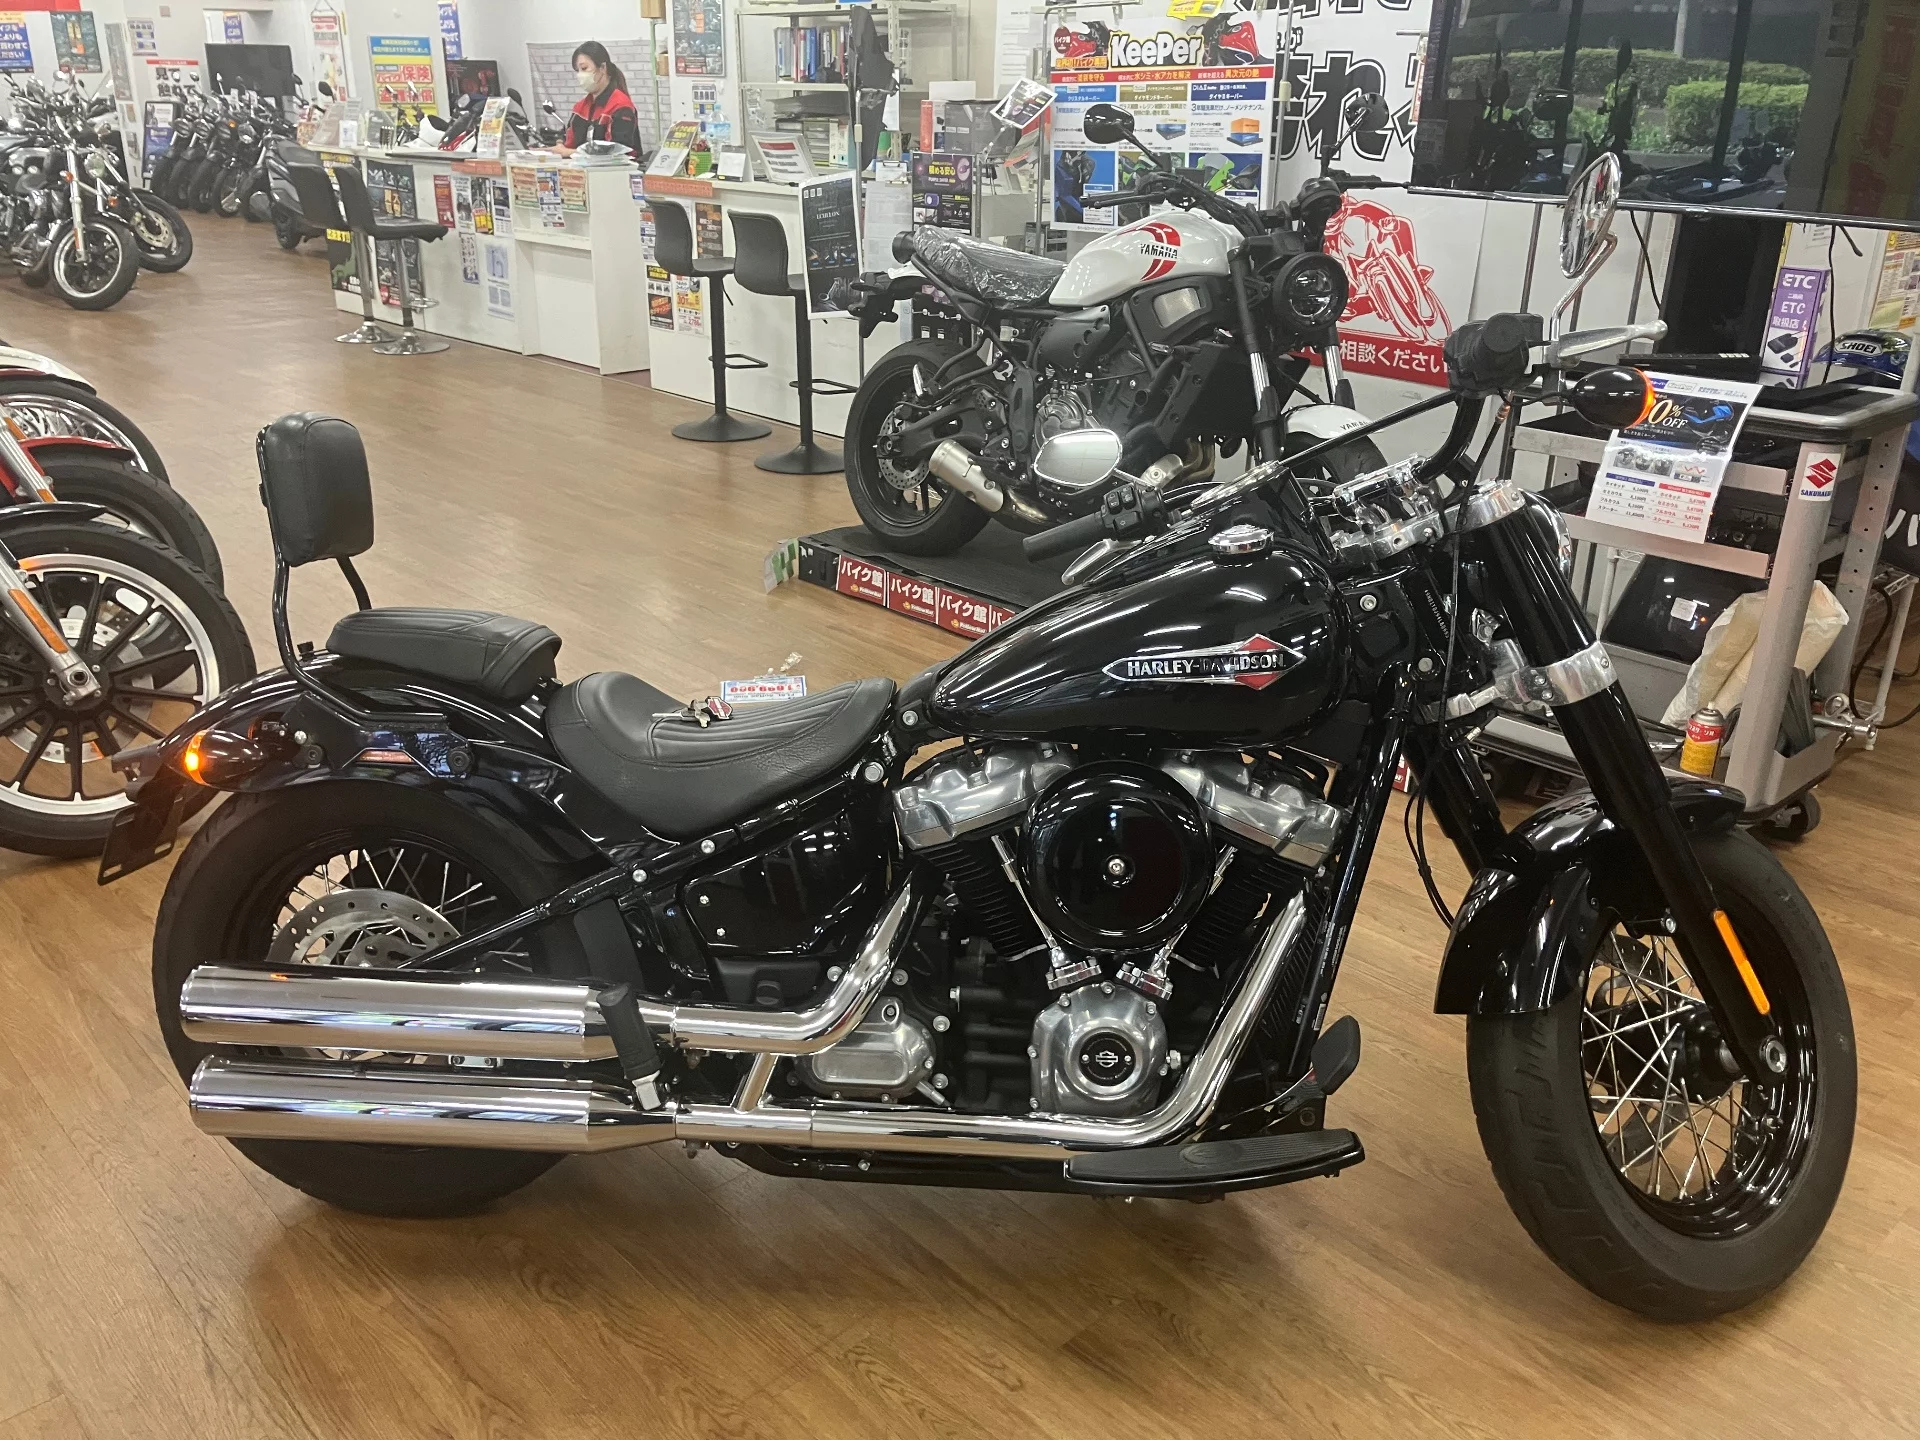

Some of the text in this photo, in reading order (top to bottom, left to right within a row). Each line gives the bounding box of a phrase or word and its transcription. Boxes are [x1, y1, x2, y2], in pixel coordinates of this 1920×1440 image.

[1111, 33, 1203, 68] KeePer
[1140, 243, 1178, 259] YAMAHA
[1782, 273, 1816, 289] ETC
[1780, 301, 1806, 315] ETC
[1839, 341, 1878, 354] SHOEI
[1662, 417, 1689, 429] OFF
[841, 560, 883, 588] バイク館
[891, 577, 935, 606] バイク館
[940, 594, 988, 624] バイク館
[1127, 653, 1285, 678] HARLEY-DAVIDSON
